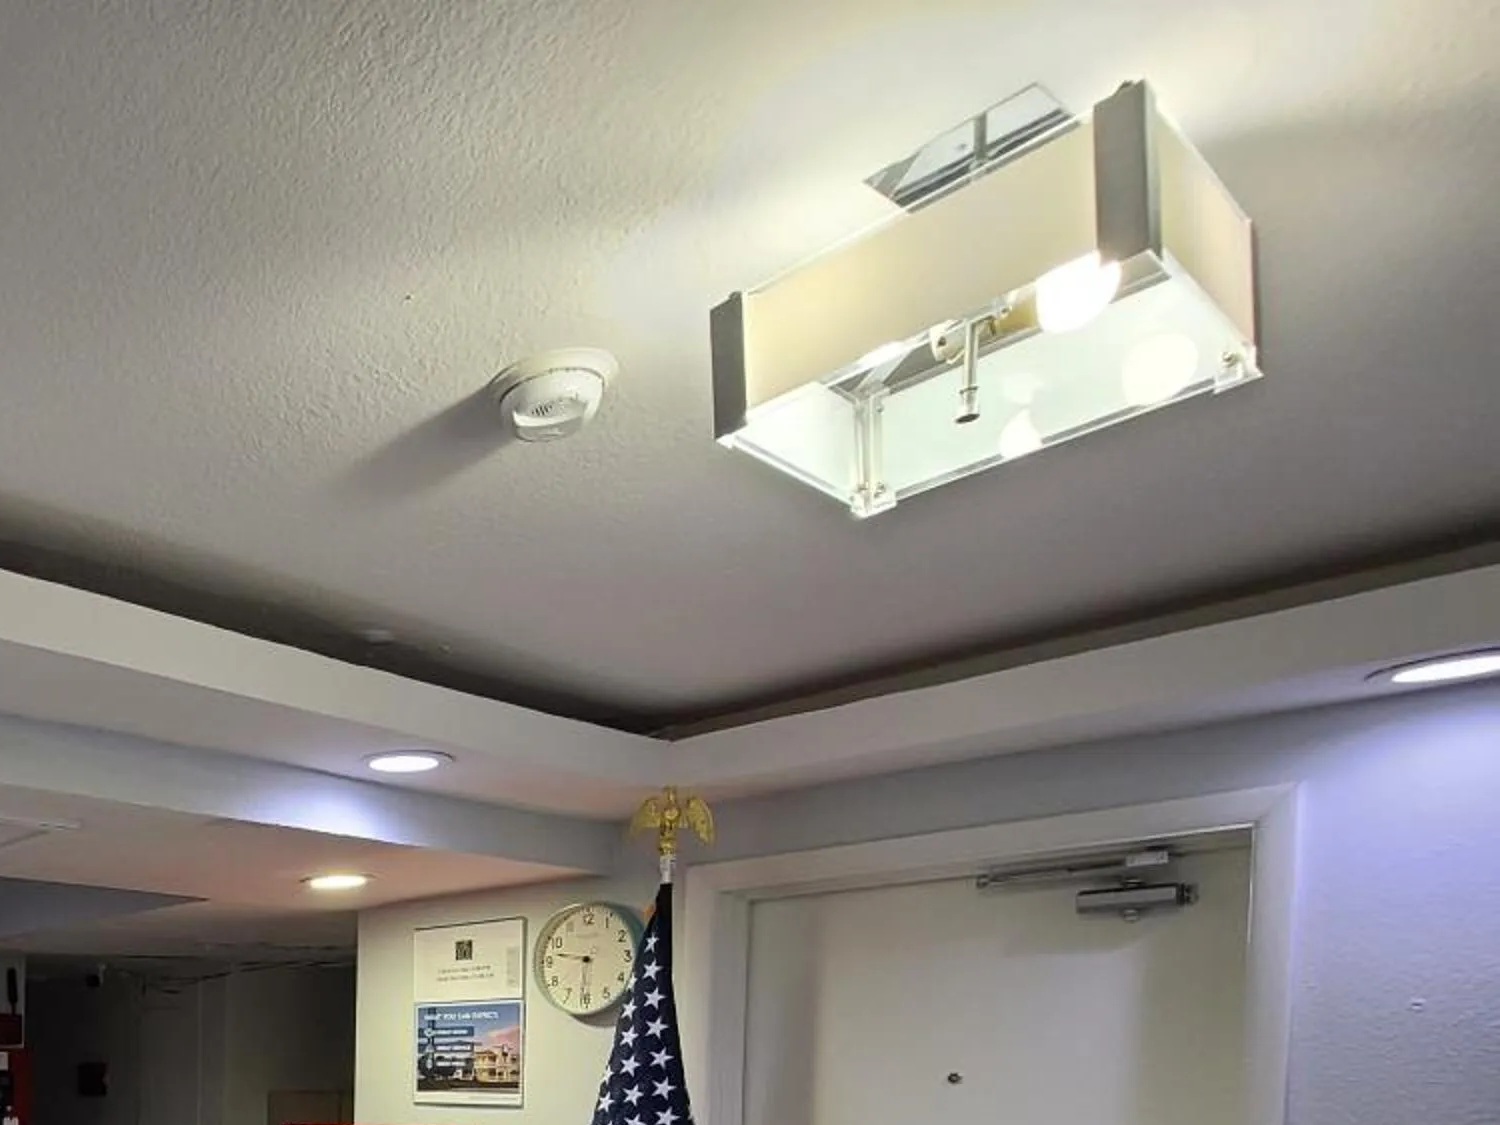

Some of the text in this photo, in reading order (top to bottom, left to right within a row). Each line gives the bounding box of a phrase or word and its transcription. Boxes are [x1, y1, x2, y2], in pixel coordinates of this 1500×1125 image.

[550, 935, 563, 949] 10
[617, 929, 627, 943] 2
[623, 949, 632, 963] 3
[617, 971, 625, 982] 4
[602, 986, 611, 999] 5
